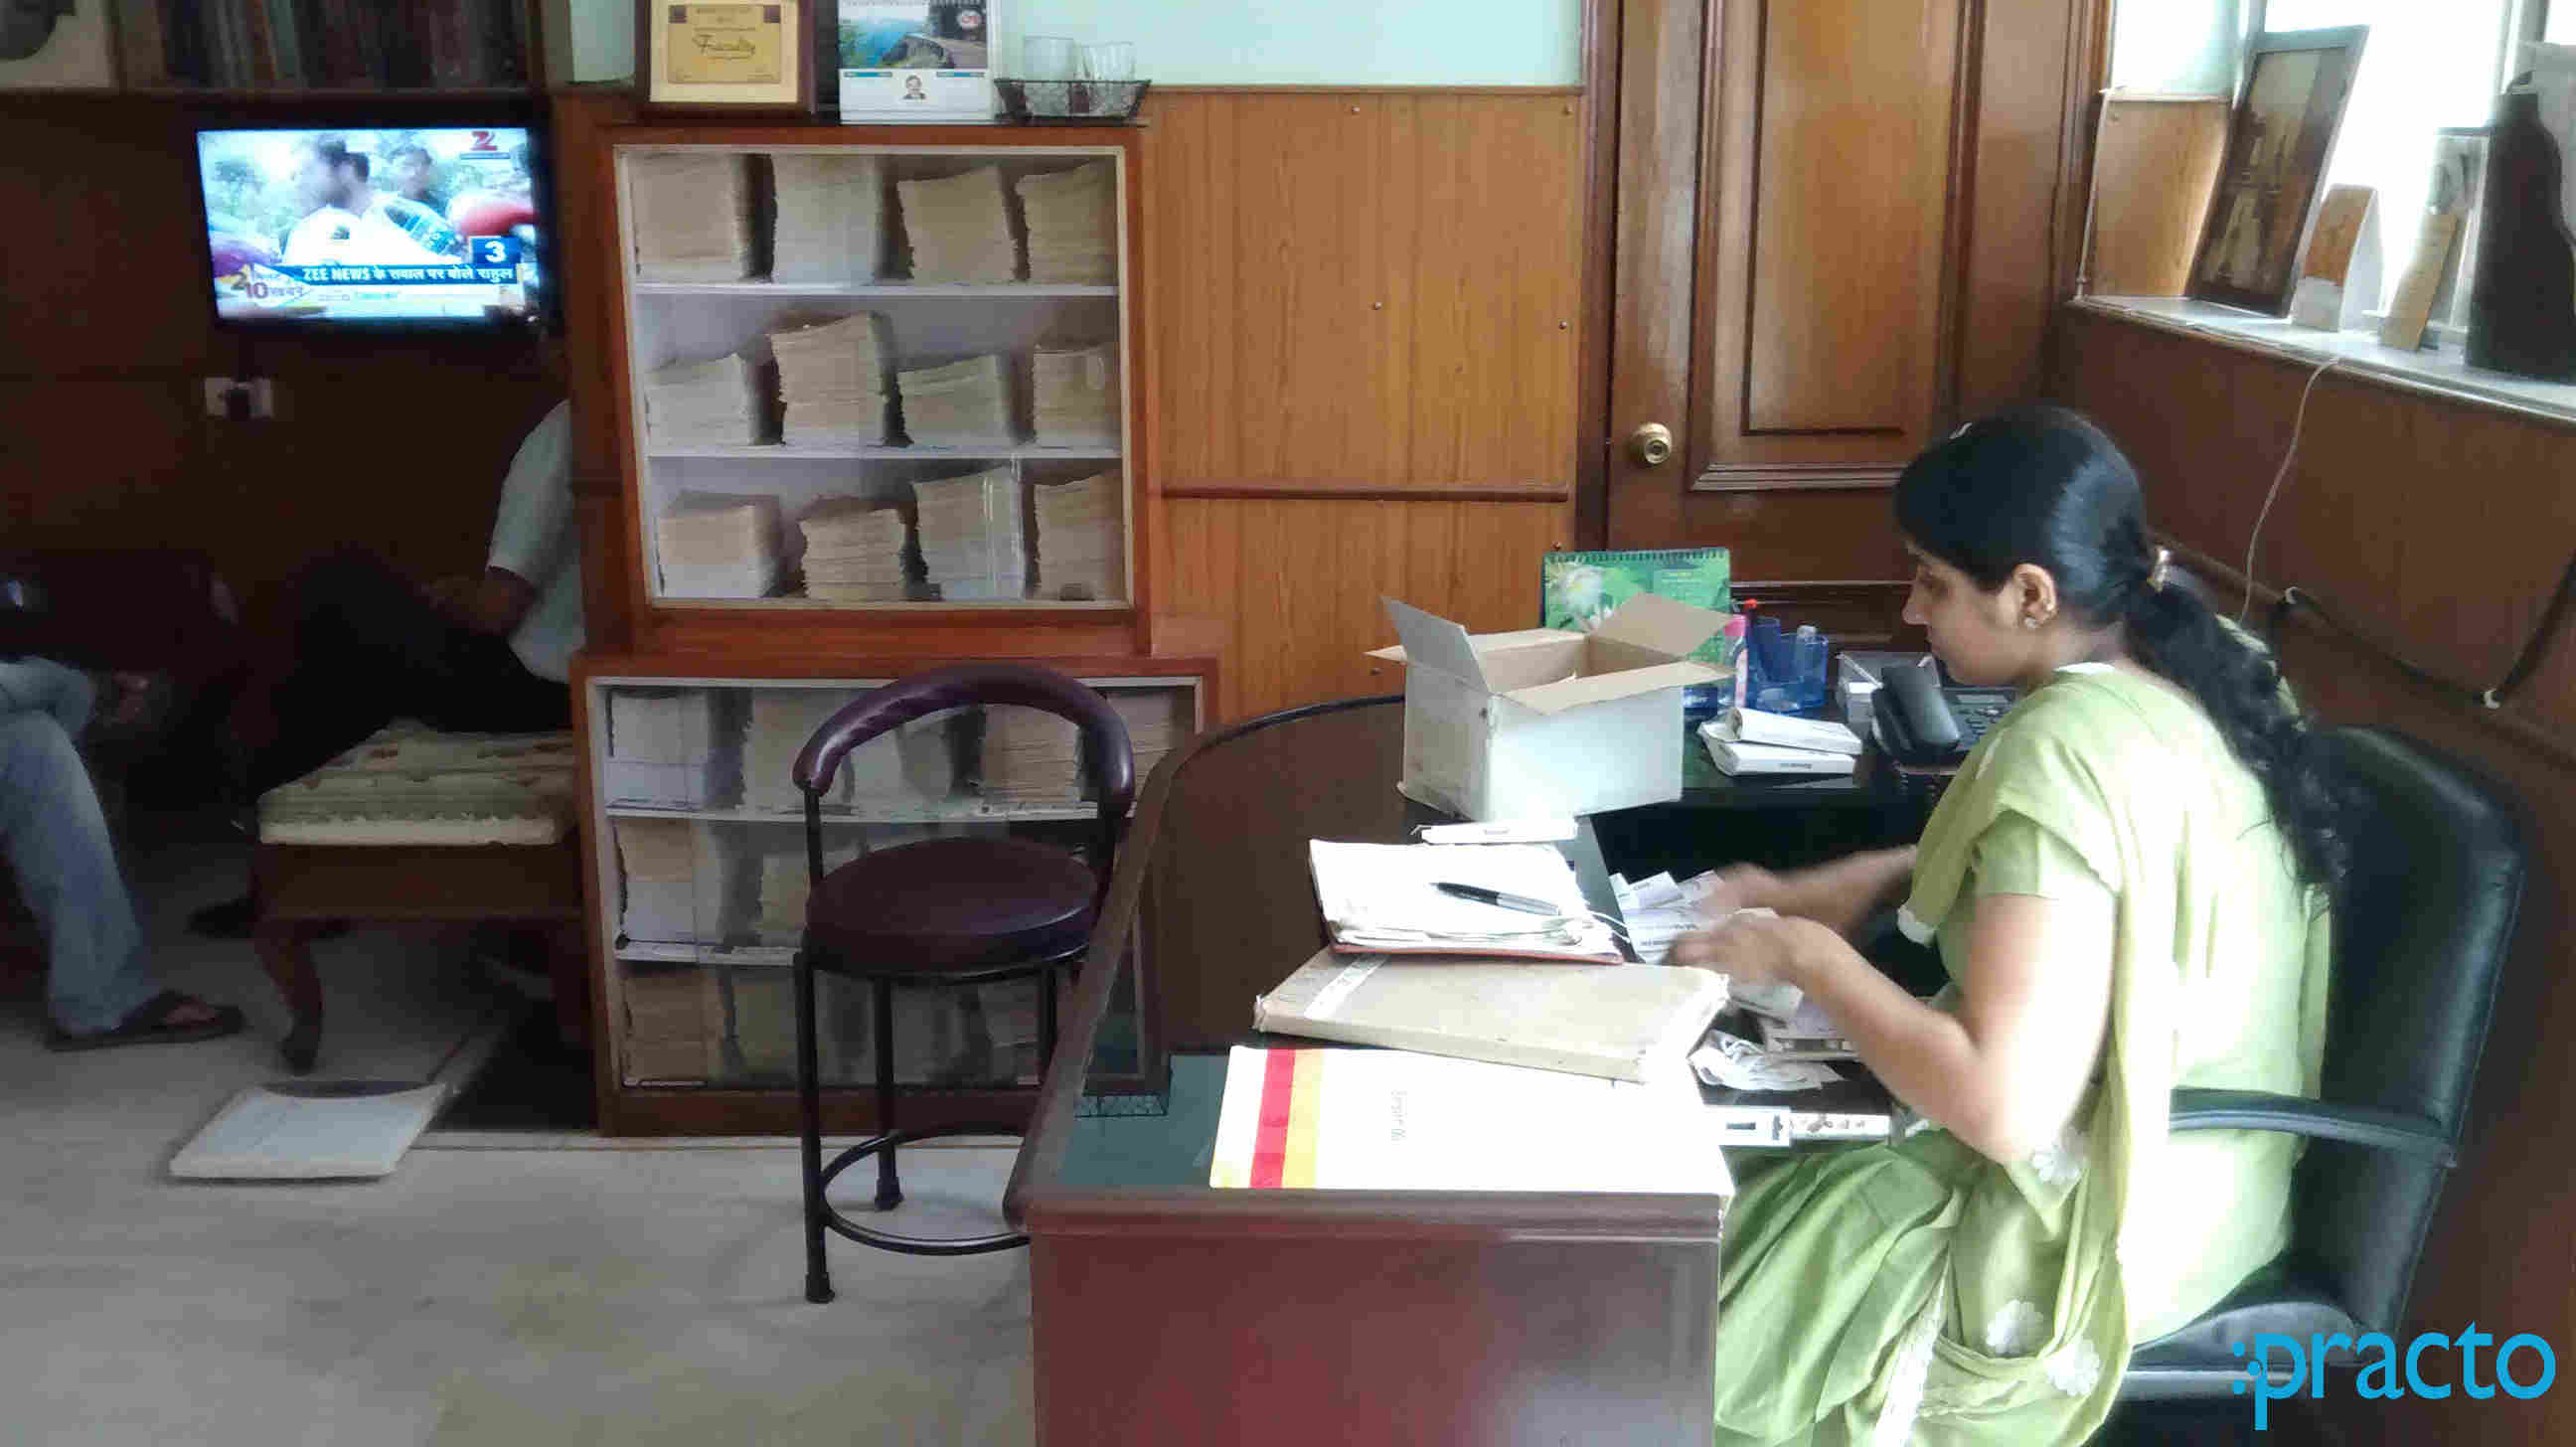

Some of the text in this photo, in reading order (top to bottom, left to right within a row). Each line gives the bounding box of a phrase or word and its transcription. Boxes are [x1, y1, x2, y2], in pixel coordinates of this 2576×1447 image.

[484, 241, 507, 262] 3
[302, 267, 329, 280] ZEE
[331, 267, 372, 280] NEWS
[426, 267, 445, 279] पर
[476, 267, 513, 283] राहुल
